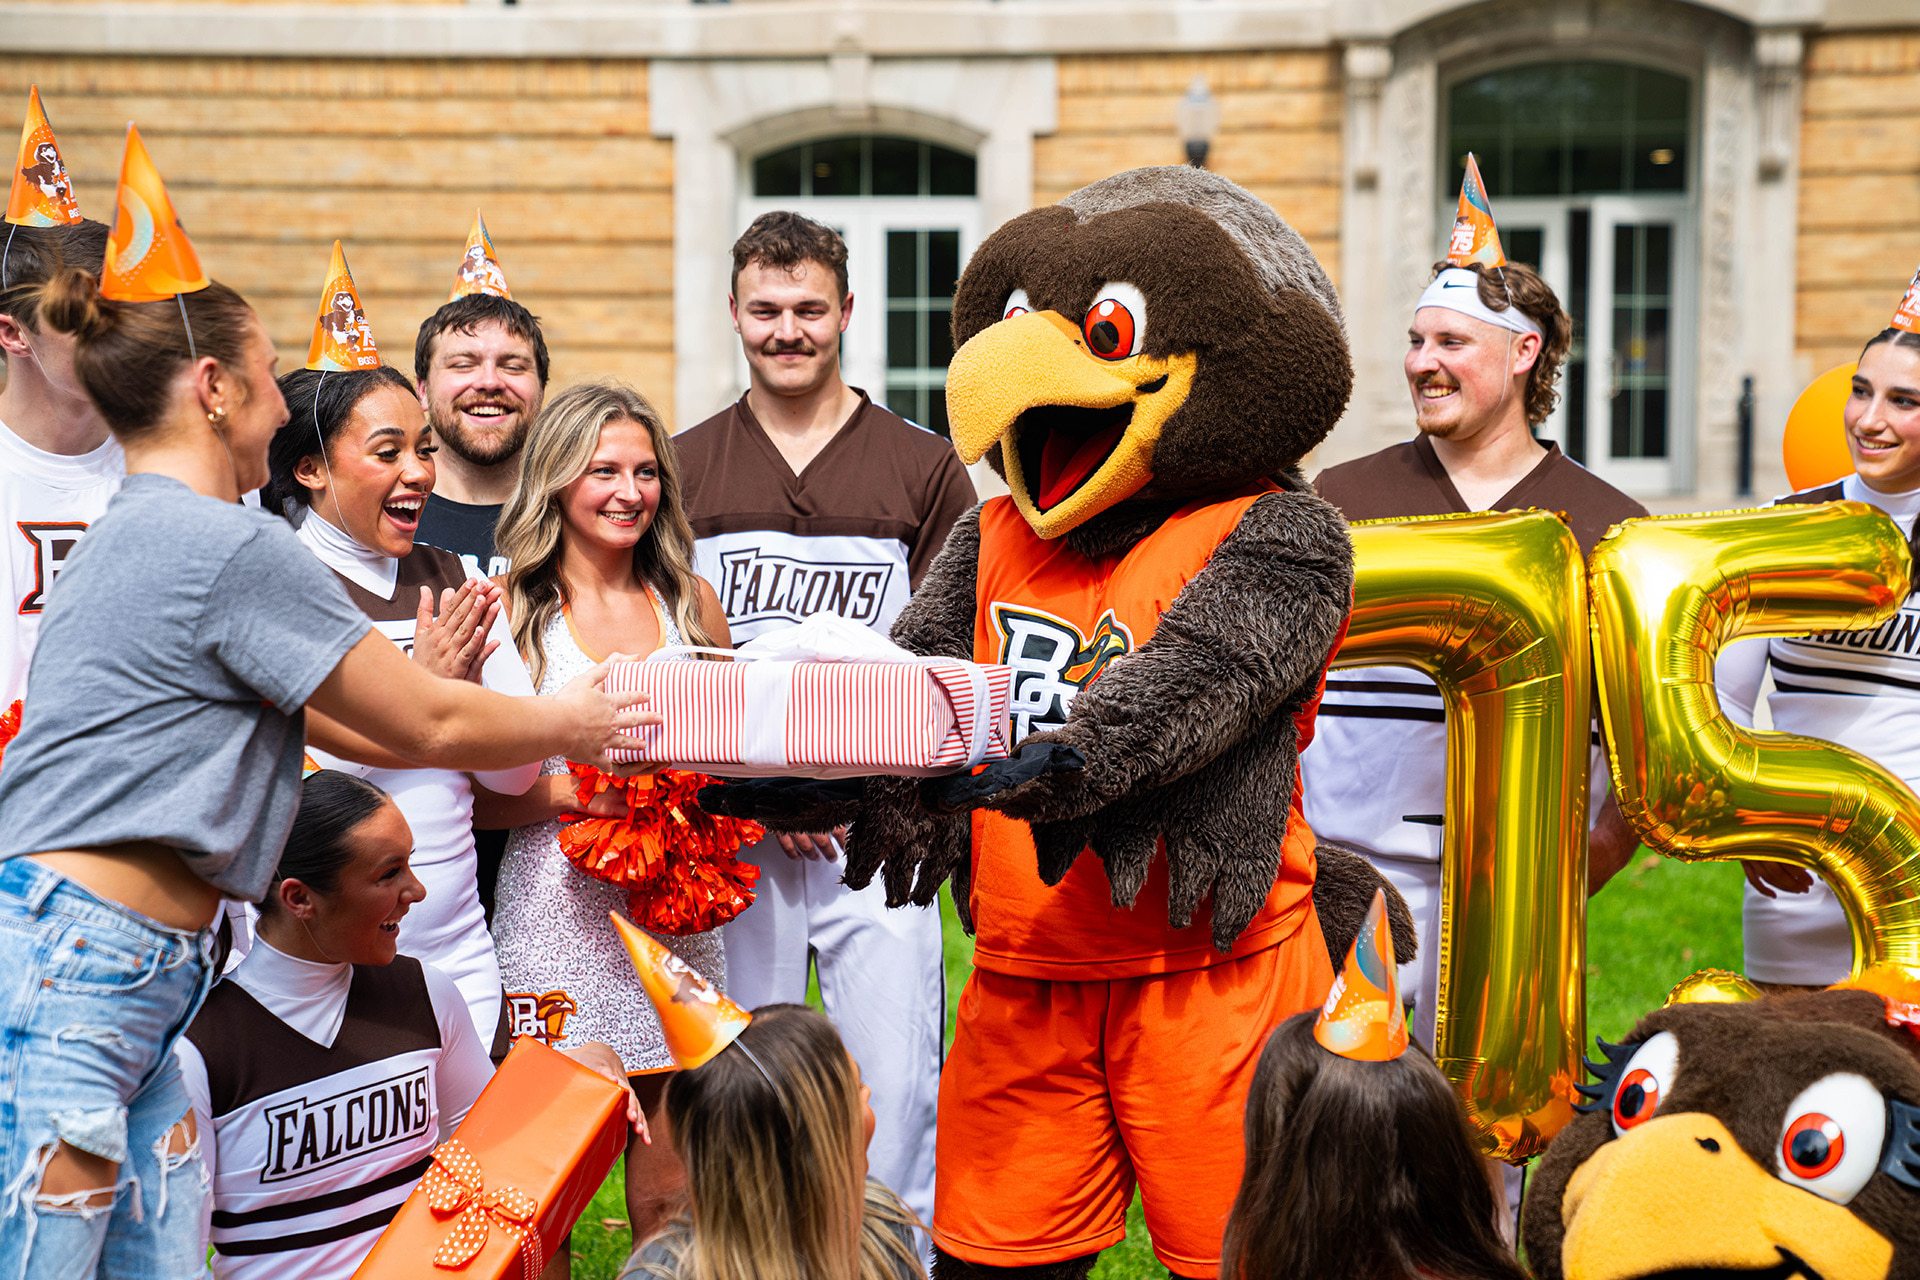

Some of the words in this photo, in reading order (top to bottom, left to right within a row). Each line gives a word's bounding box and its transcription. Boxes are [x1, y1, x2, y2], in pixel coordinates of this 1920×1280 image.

[1451, 230, 1475, 252] 75
[725, 557, 884, 619] FALCONS
[269, 1075, 428, 1176] FALCONS
